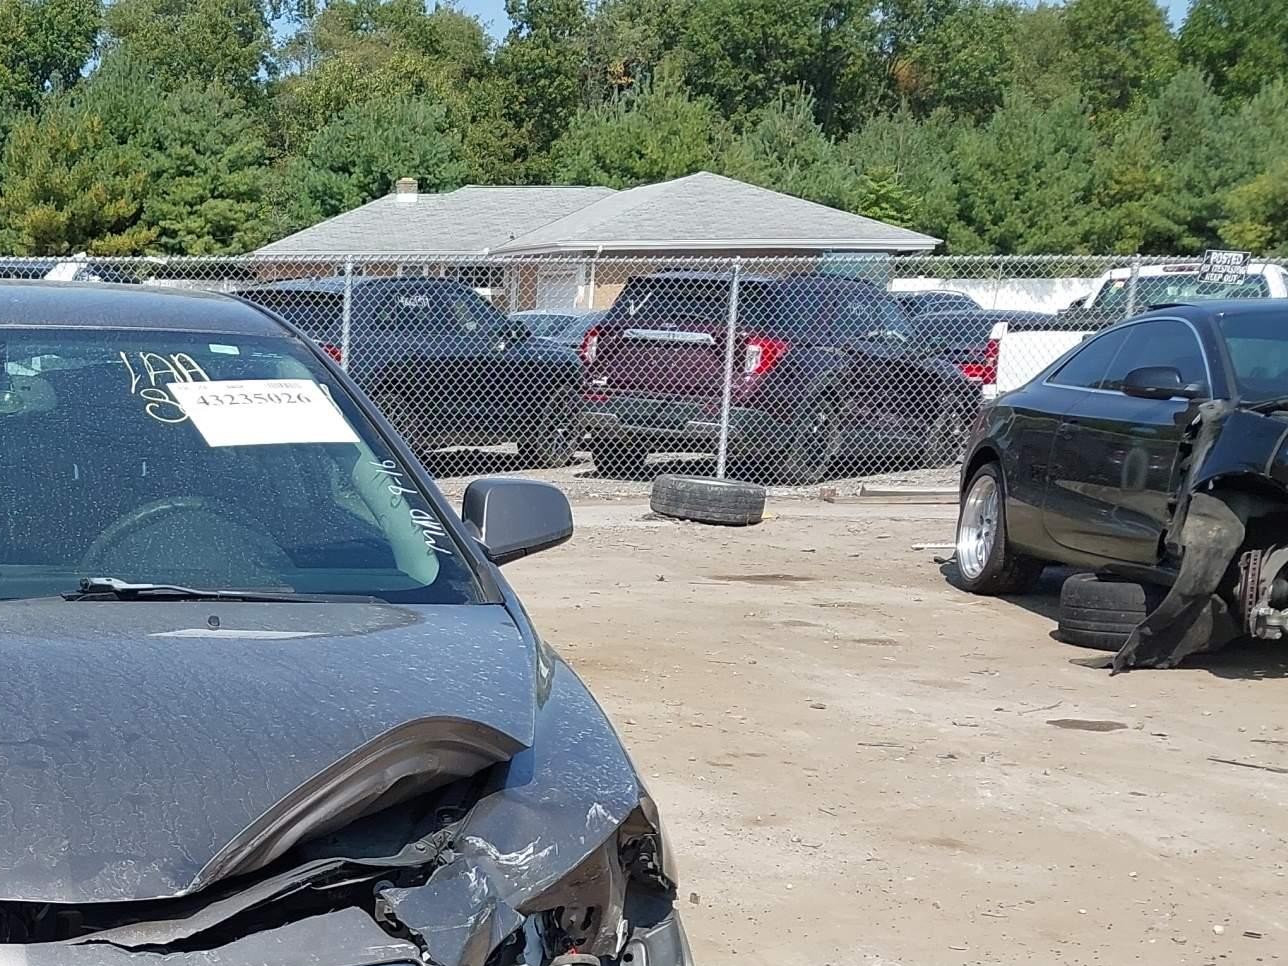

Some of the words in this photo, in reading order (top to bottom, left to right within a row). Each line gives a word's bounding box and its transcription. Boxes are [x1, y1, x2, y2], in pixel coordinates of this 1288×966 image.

[1210, 251, 1244, 265] POSTED
[1205, 273, 1222, 281] KEEP
[1223, 273, 1238, 282] OUT
[197, 392, 313, 408] 43235026
